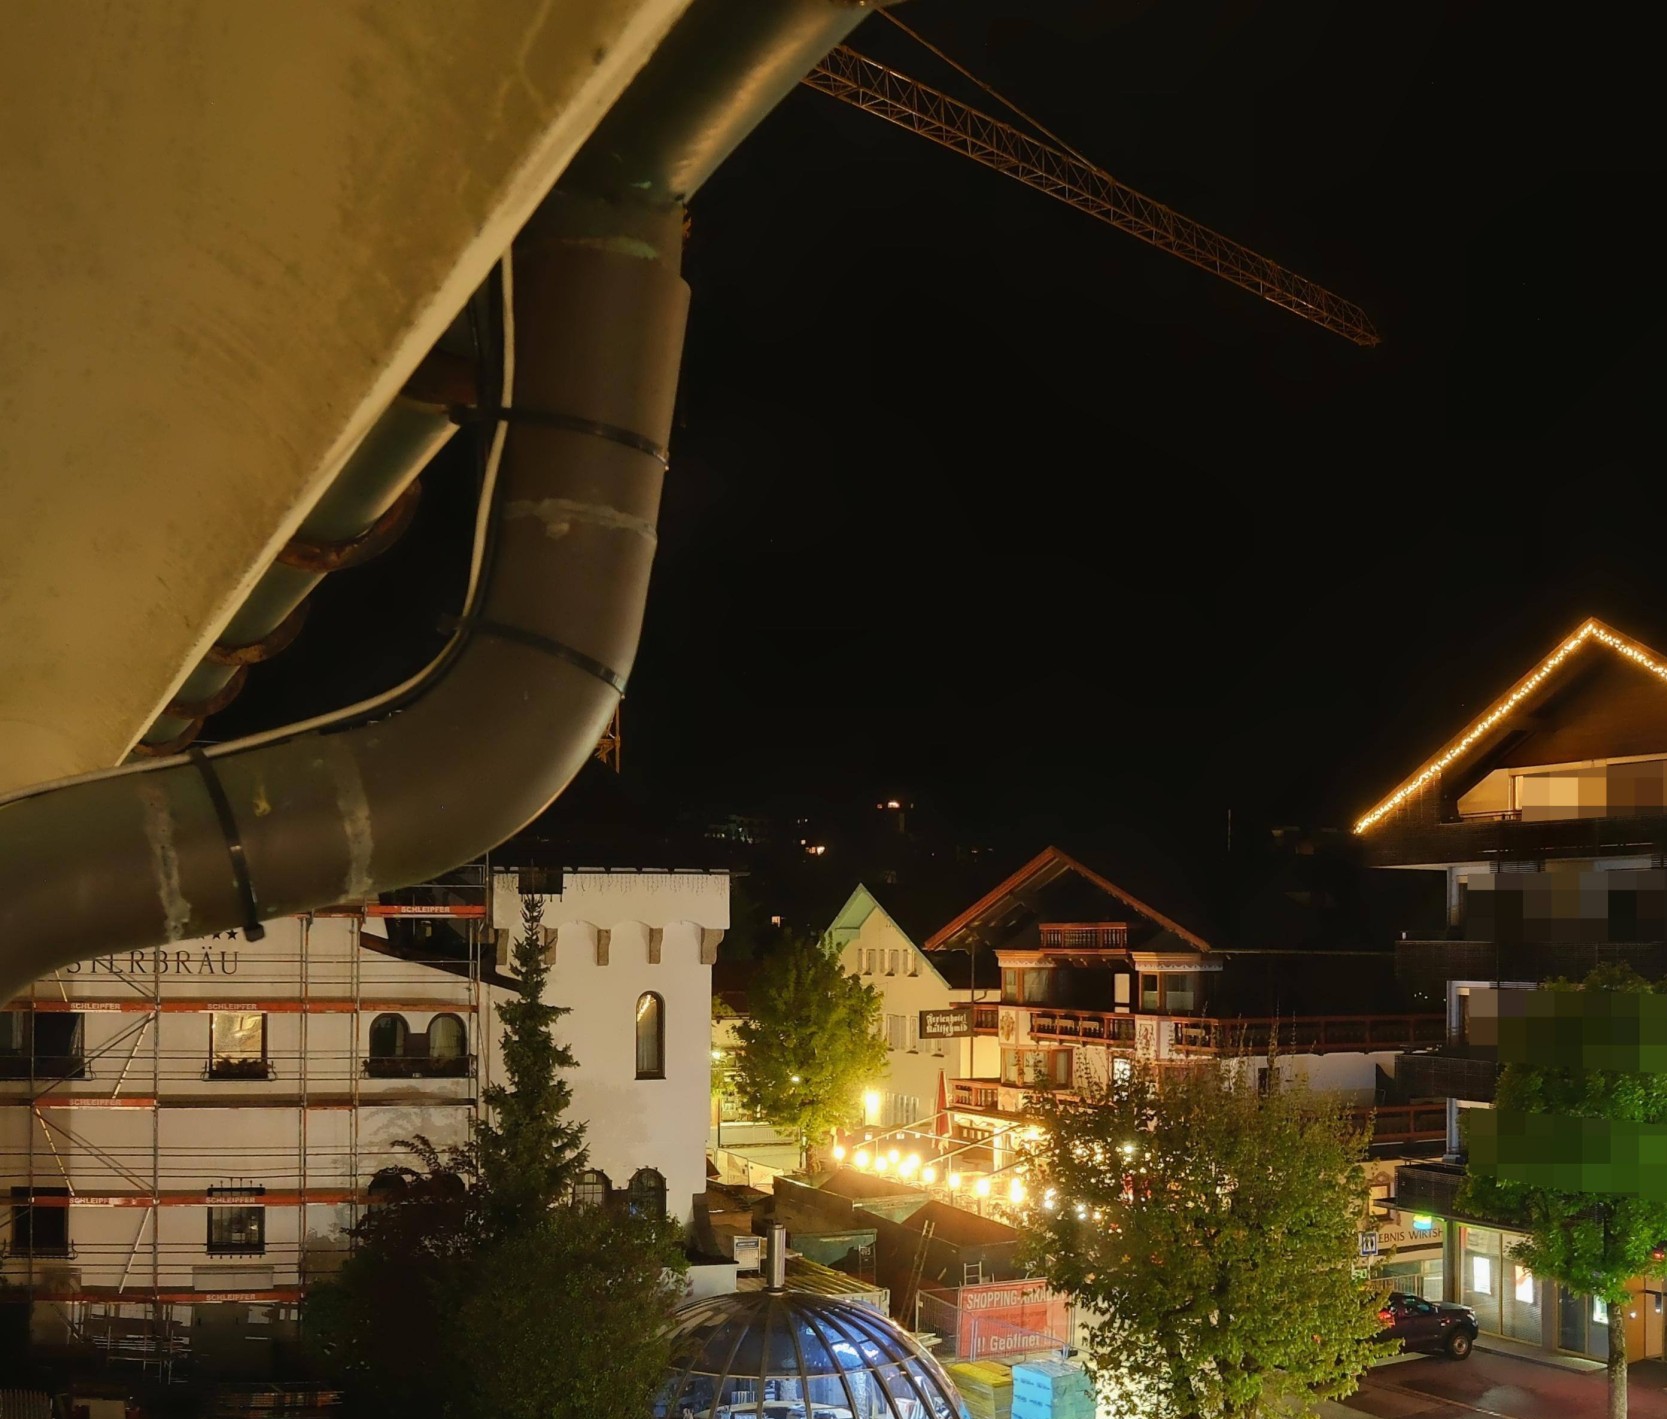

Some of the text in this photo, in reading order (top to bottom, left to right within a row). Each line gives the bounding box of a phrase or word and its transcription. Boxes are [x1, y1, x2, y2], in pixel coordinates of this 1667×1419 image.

[401, 905, 450, 913] SCHLEIPFER
[70, 1002, 121, 1010] SCHLEIPFER
[207, 1002, 258, 1010] SCHLEIPFER
[206, 1196, 255, 1204] SCHLEIPFER
